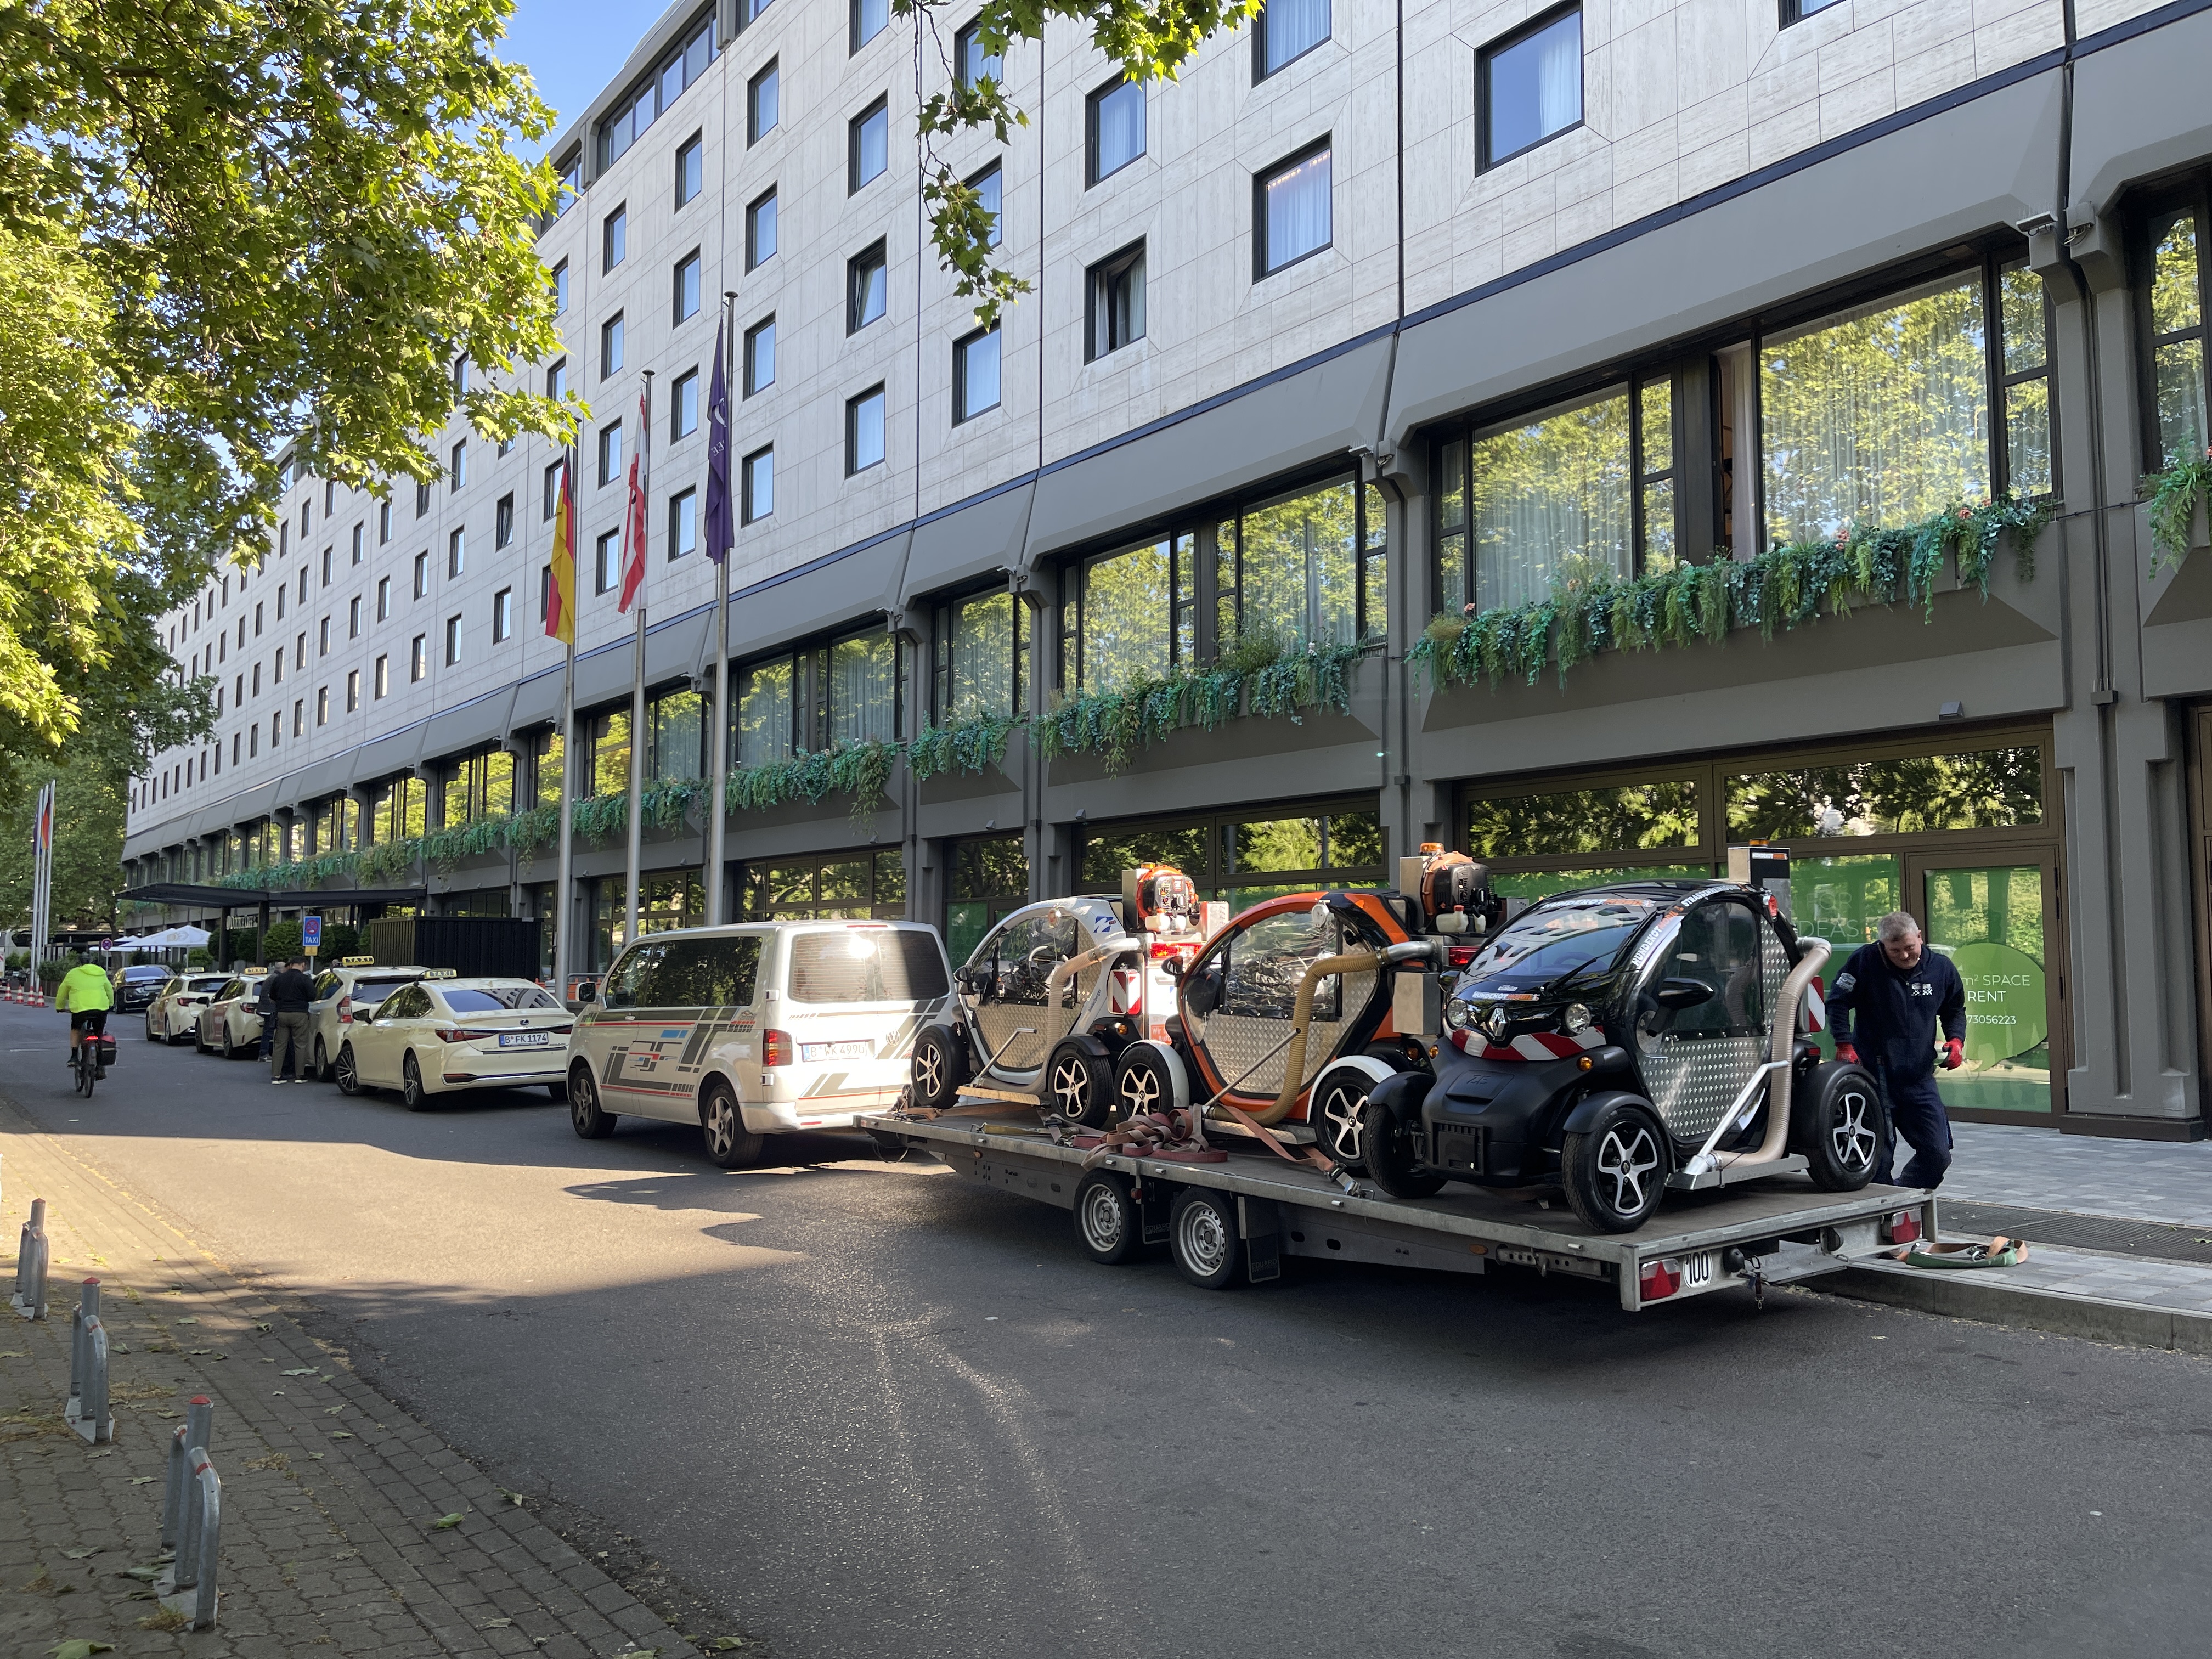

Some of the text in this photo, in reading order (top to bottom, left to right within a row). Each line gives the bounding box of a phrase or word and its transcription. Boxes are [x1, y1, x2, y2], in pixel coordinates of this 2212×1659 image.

[1807, 892, 1852, 910] FOR
[1798, 919, 1859, 938] DEAS
[1983, 975, 2031, 986] SPACE
[1967, 991, 2006, 1002] RENT
[1966, 1015, 2017, 1025] 73056223
[505, 1036, 510, 1044] B
[527, 1034, 546, 1042] 1174
[810, 1044, 865, 1057] B WK 4990
[1685, 1250, 1709, 1284] 100
